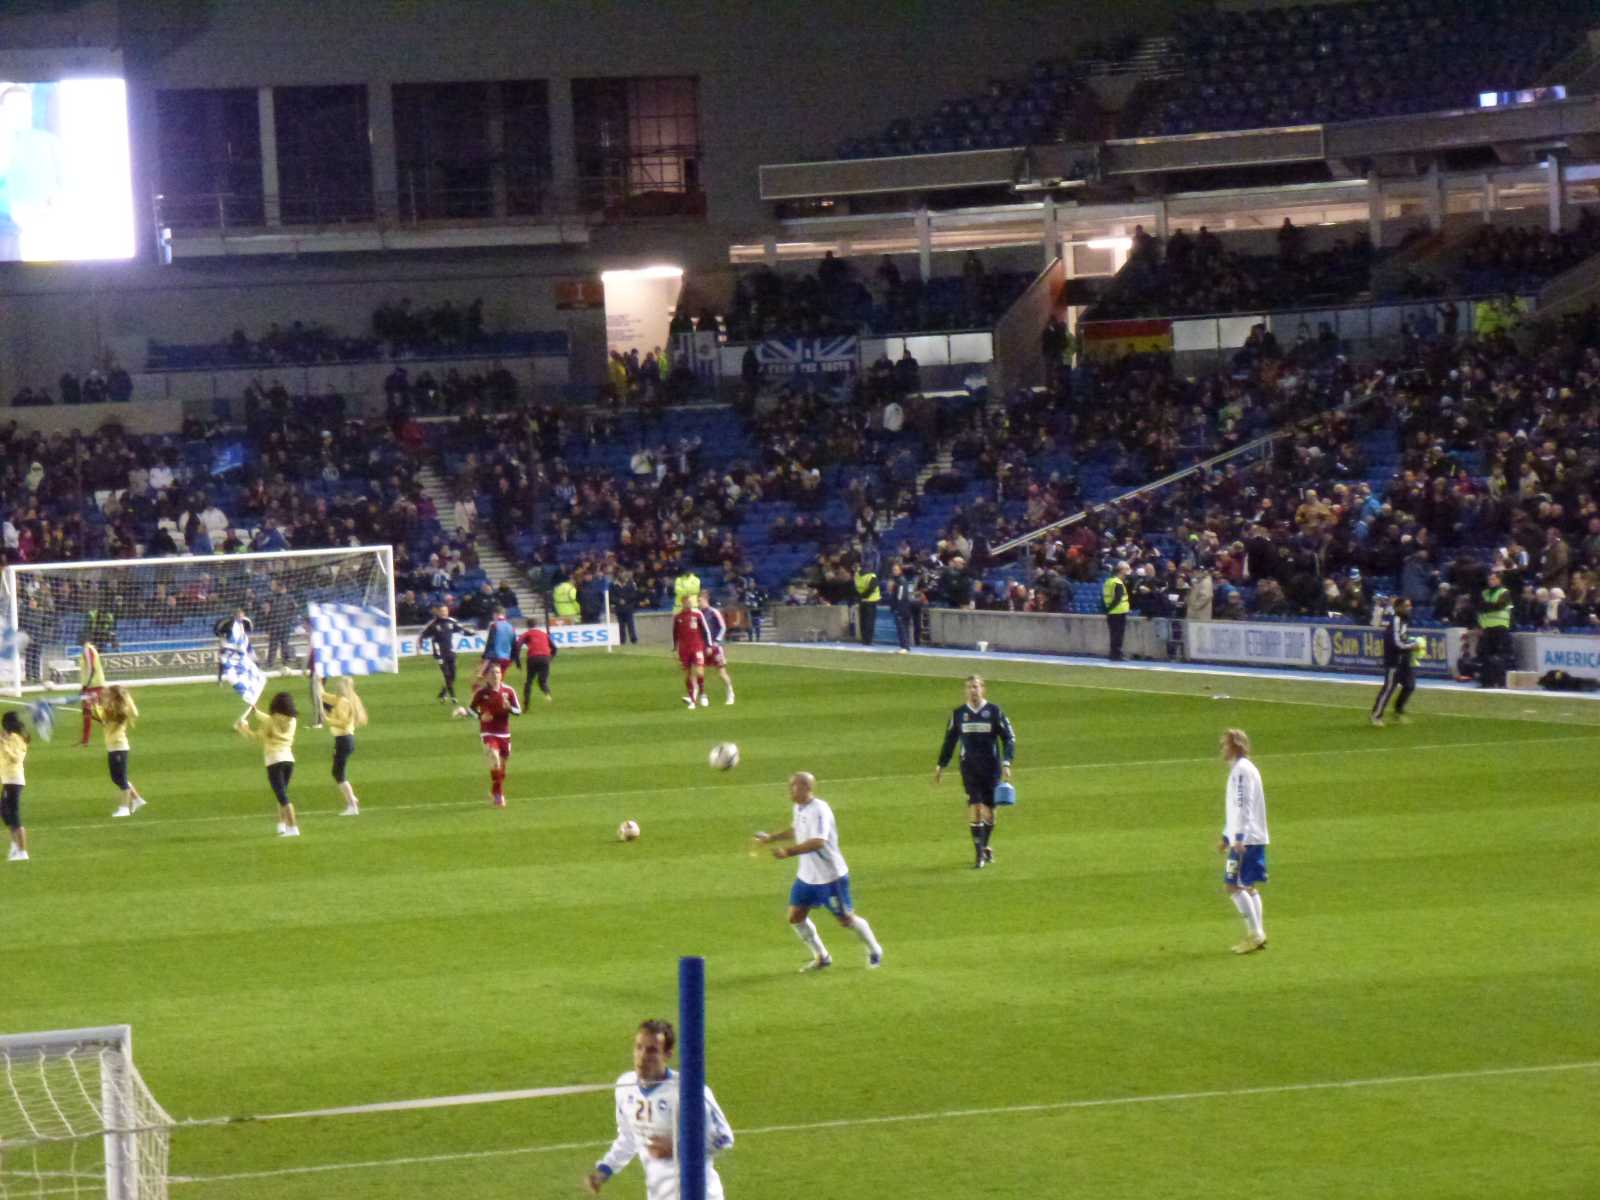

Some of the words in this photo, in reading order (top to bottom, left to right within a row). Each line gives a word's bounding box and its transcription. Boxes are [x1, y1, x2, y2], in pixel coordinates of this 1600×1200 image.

[551, 629, 608, 645] RESS
[1363, 632, 1384, 657] Ha
[636, 1101, 652, 1122] 21
